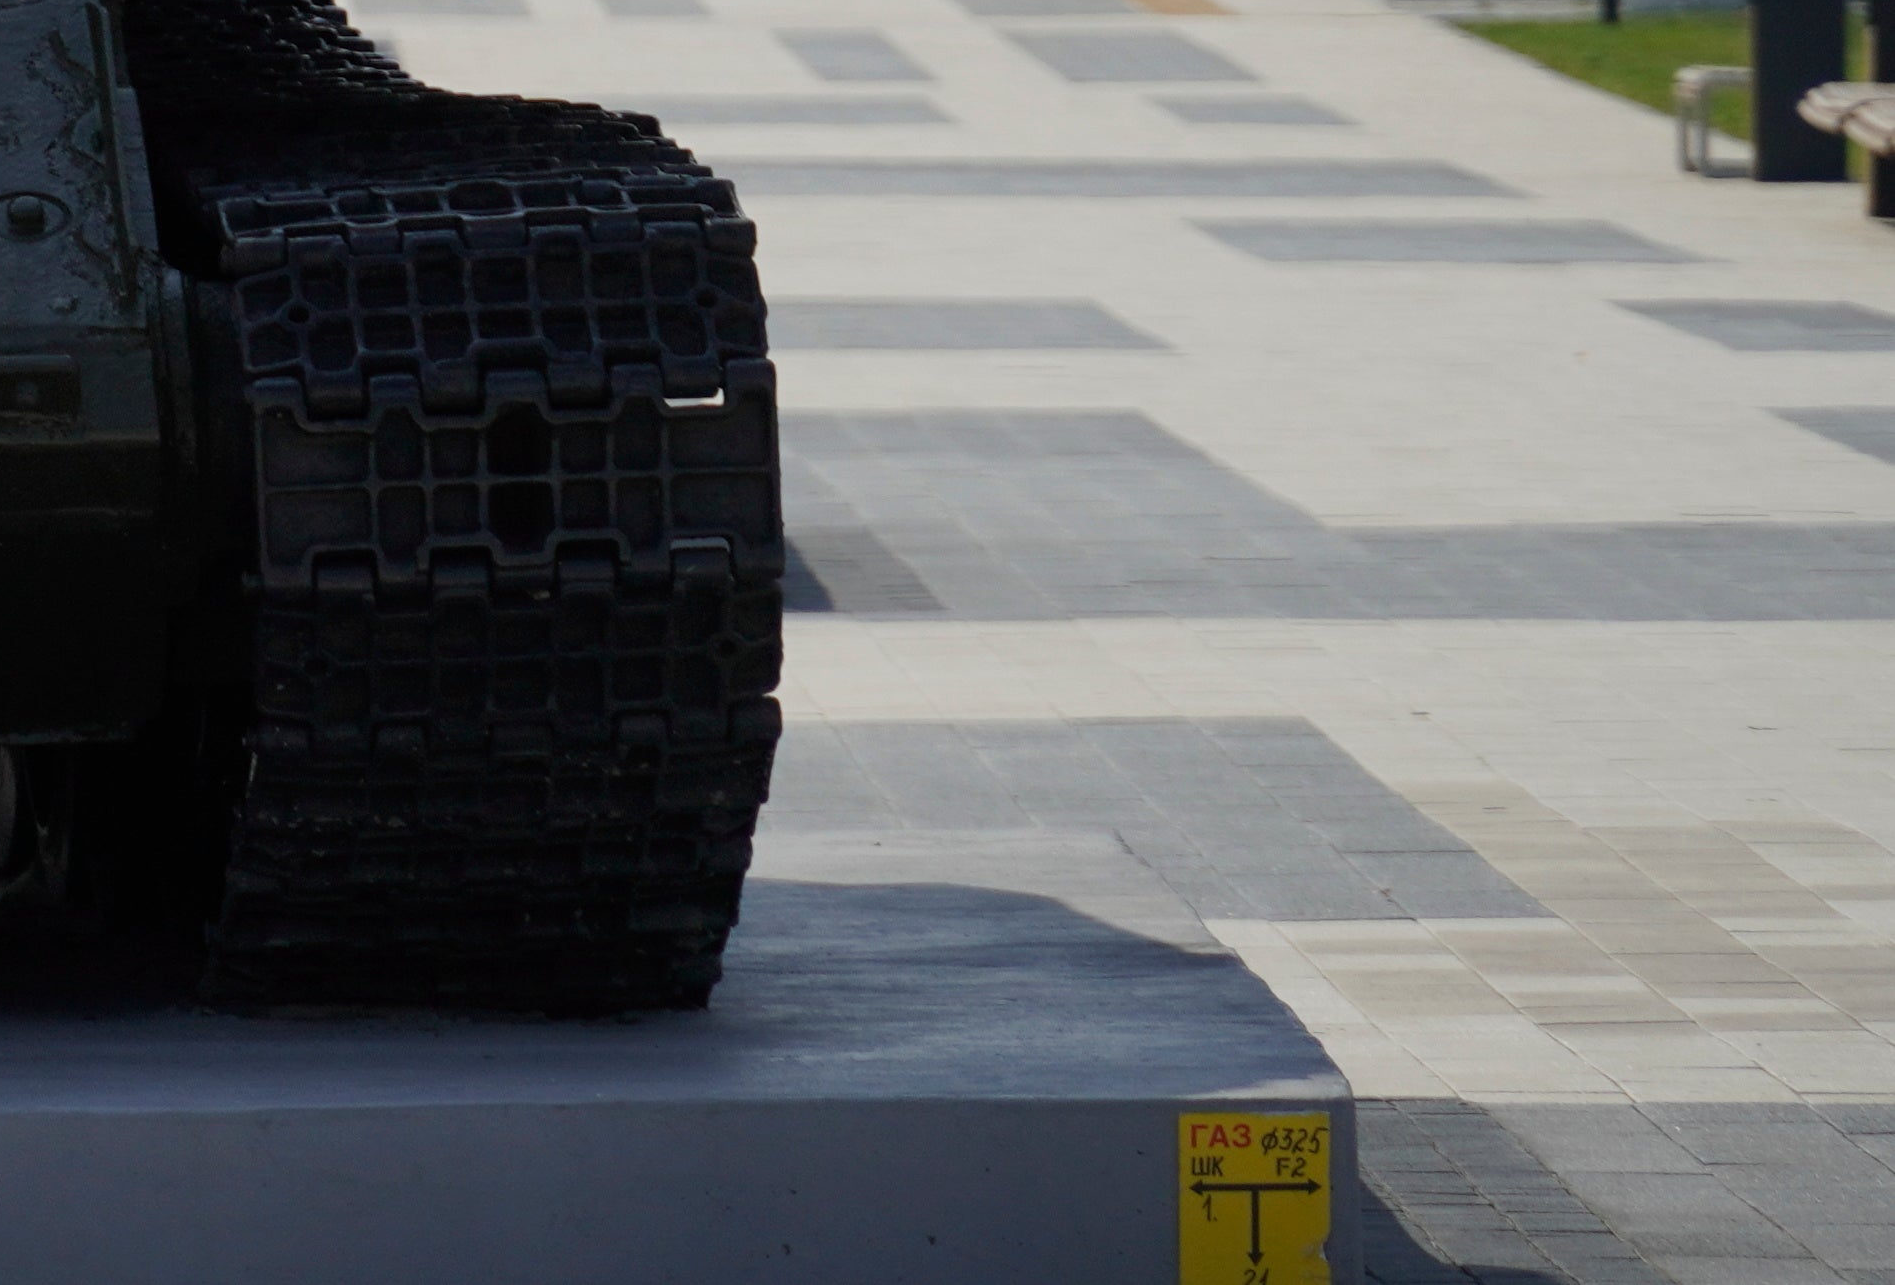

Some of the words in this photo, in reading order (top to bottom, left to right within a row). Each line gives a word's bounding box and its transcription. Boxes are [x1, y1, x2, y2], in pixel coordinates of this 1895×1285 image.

[1189, 1123, 1252, 1149] ГАЗ
[1191, 1156, 1224, 1177] ШК
[1276, 1157, 1307, 1178] F2
